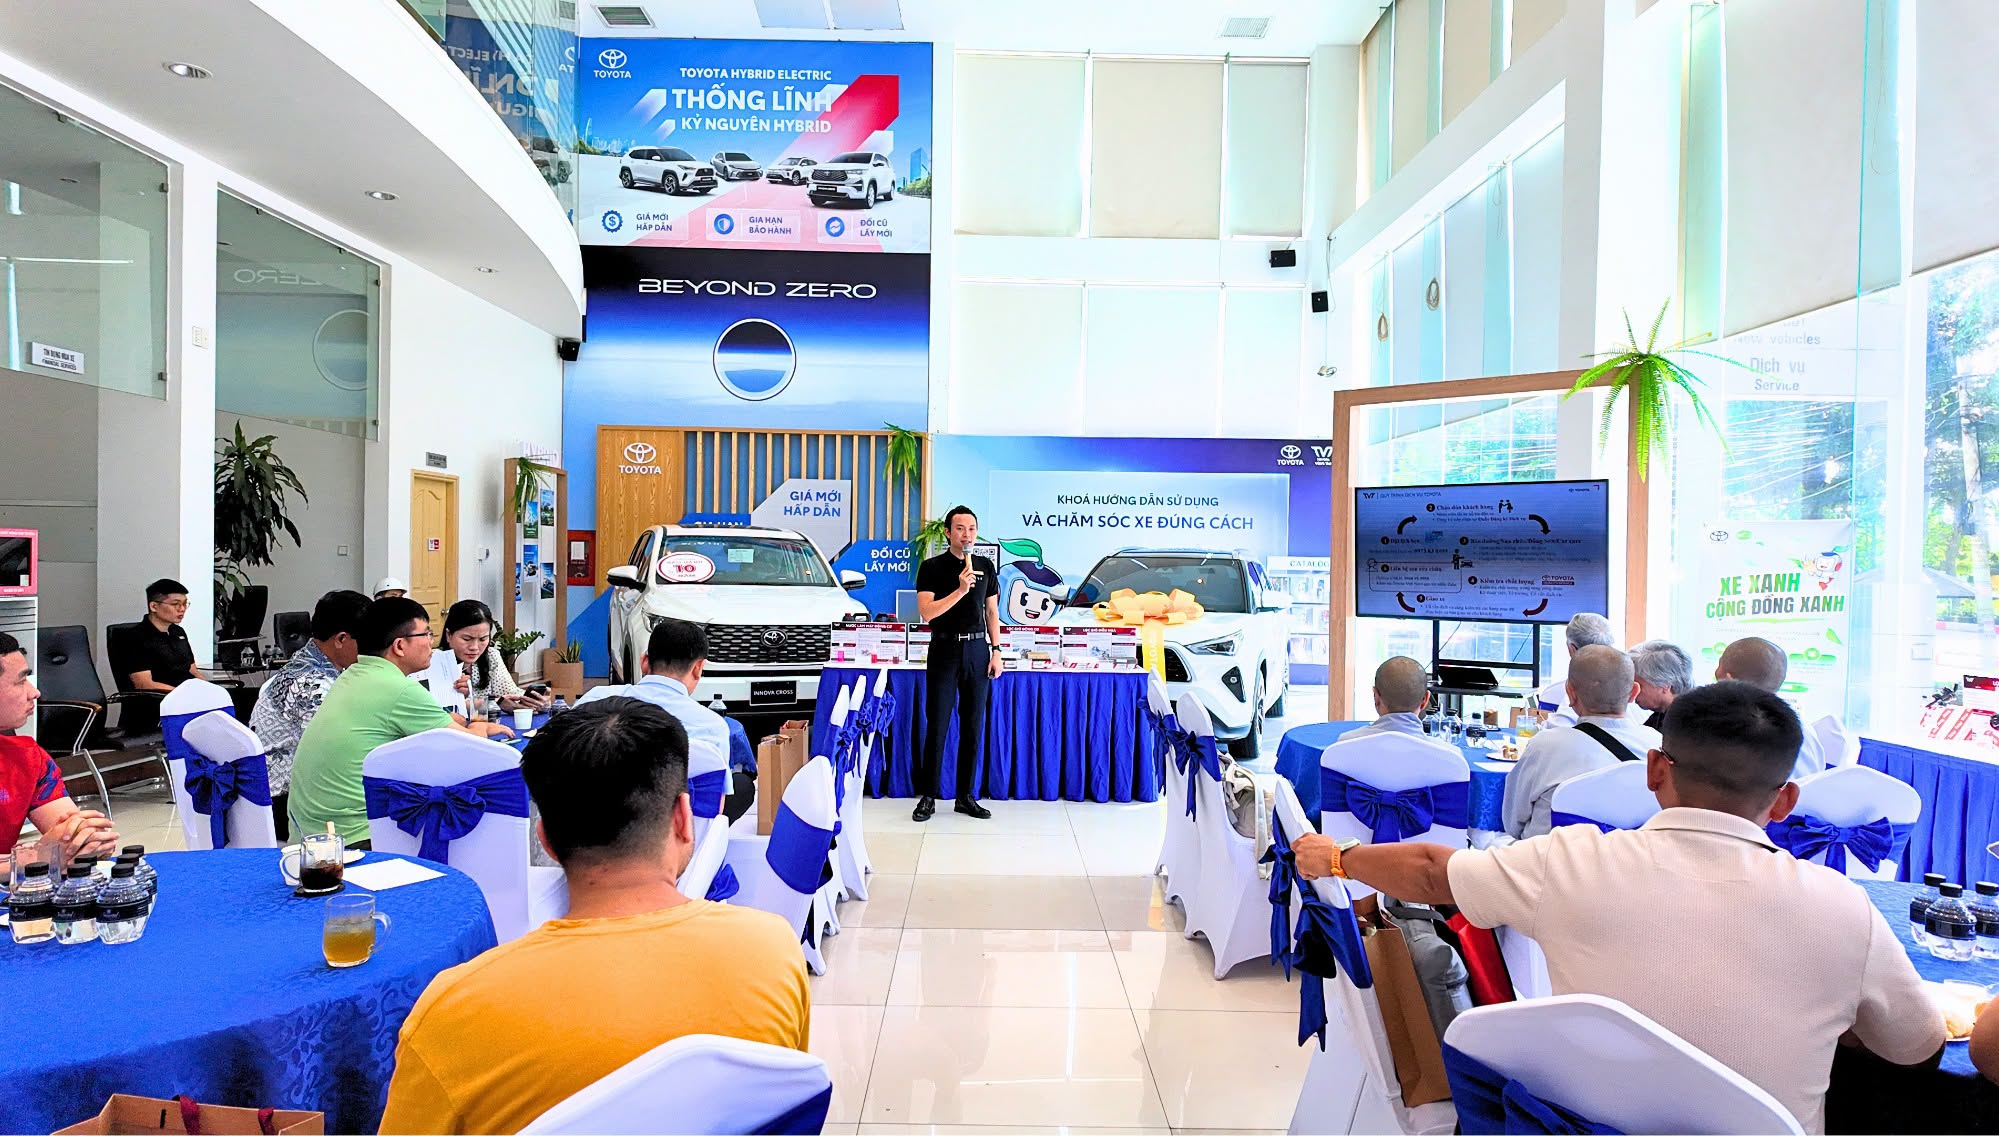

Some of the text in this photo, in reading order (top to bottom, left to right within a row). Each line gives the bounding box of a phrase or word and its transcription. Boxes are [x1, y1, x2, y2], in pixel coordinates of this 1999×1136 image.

[593, 70, 632, 79] TOYOTA
[680, 68, 832, 81] TOYOTA HYBRID ELECTRIC
[672, 82, 832, 112] THỐNG LĨNH
[681, 113, 832, 133] KỶ NGUYÊN HYBRID
[636, 212, 669, 221] GIÁ MỚI
[749, 216, 783, 226] GIA HẠN
[876, 218, 888, 227] CŨ
[768, 225, 792, 235] HÀNH
[876, 229, 893, 237] MỚI
[638, 279, 877, 299] BEYOND ZERO
[1754, 378, 1800, 391] Service
[618, 465, 662, 474] TOYOTA
[790, 489, 841, 502] GIÁ MỚI
[1057, 492, 1219, 509] KHOÁ HƯỚNG DẪN SỬ DỤNG
[784, 503, 841, 517] HẤP DẪN
[1022, 511, 1253, 529] VÀ CHĂM SÓC XE ĐÚNG CÁCH
[871, 546, 911, 559] ĐỔI CŨ
[864, 560, 911, 572] LẤY MỚI
[1720, 573, 1800, 596] XE XANH
[1705, 593, 1845, 621] CỘNG ĐỒNG XANH
